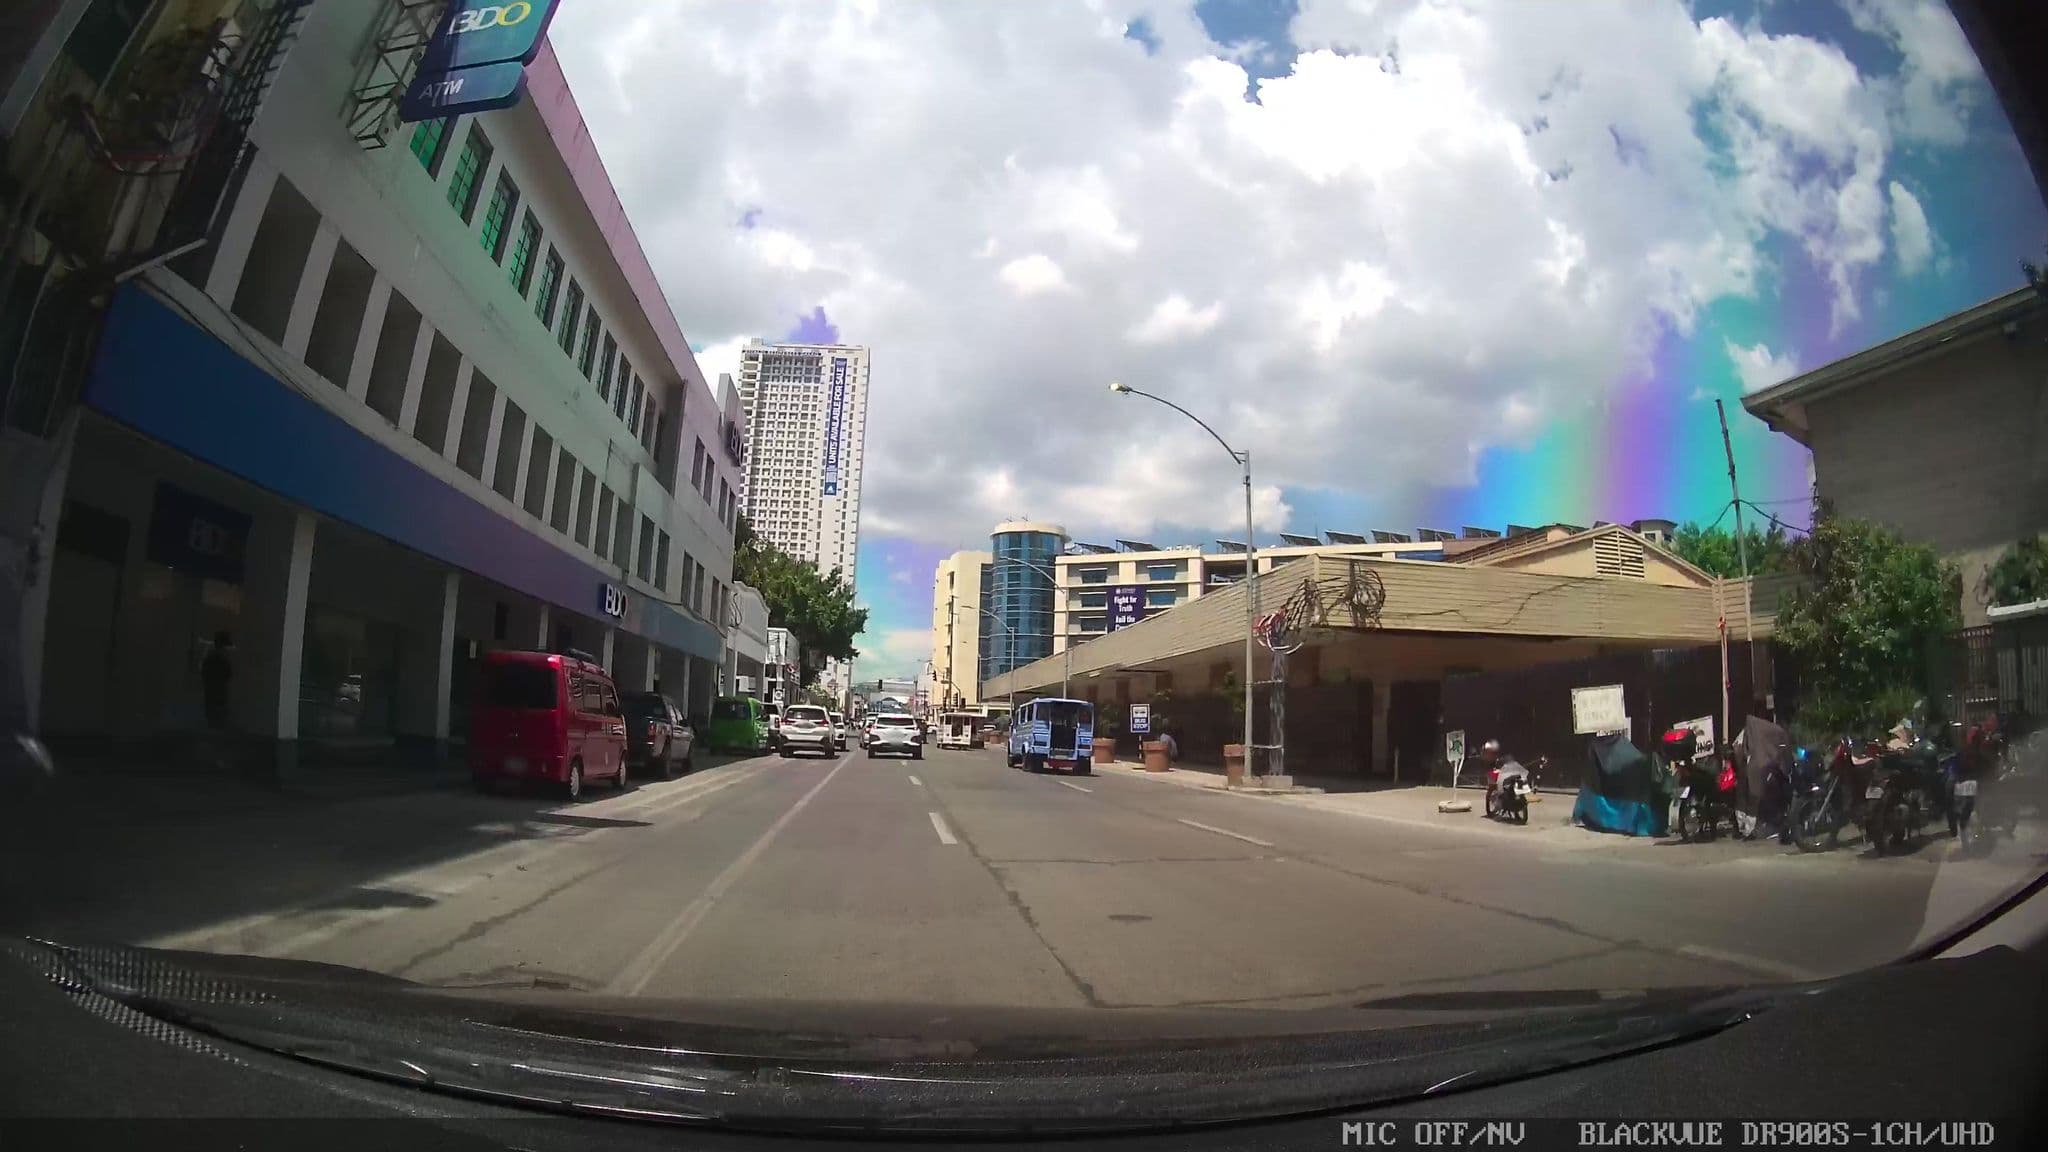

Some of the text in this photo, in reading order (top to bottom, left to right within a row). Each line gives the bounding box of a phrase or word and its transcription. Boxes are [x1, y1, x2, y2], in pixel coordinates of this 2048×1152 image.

[447, 1, 531, 35] BDO
[418, 79, 464, 107] ATM
[828, 367, 844, 464] UNITS AVAILABLE FOR SALE
[605, 584, 628, 619] BDO
[1114, 596, 1138, 605] Fight for
[1118, 604, 1133, 612] Truth
[1126, 615, 1136, 623] the
